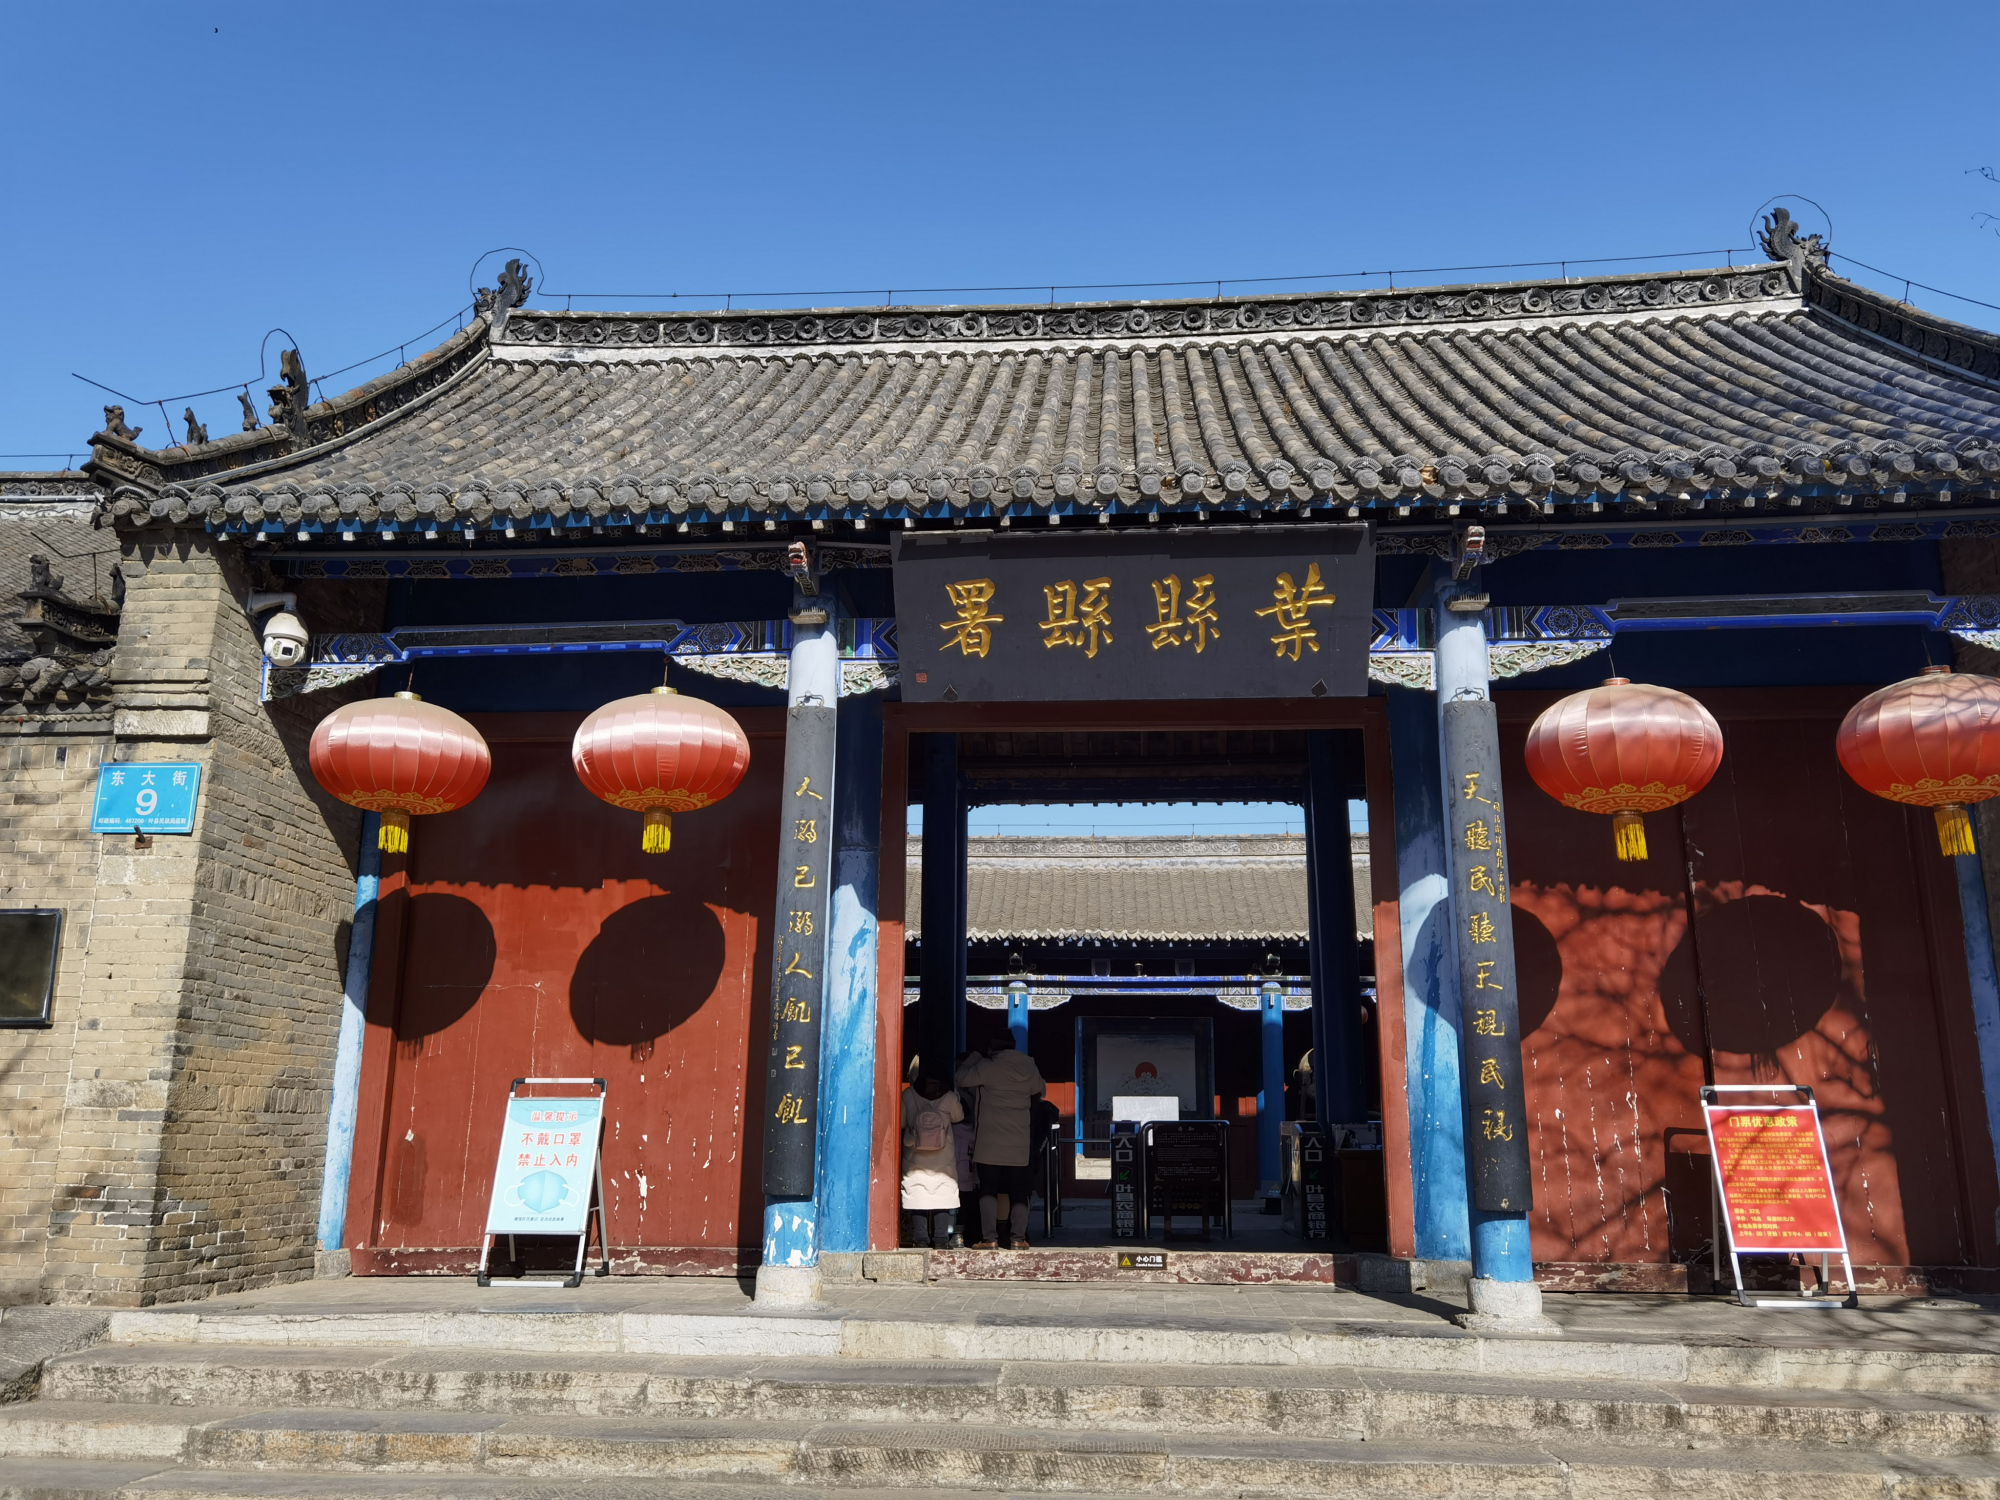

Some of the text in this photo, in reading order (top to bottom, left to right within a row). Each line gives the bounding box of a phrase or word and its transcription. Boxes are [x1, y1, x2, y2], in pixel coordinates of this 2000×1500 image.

[939, 562, 1336, 661] 葉縣縣署
[111, 770, 187, 786] 东大街
[135, 788, 158, 816] 9
[531, 1111, 578, 1122] 温馨提示
[1728, 1116, 1798, 1128] 门票优惠政策
[520, 1132, 582, 1146] 不戴口罩
[1115, 1136, 1133, 1162] 入口
[1304, 1136, 1323, 1162] 入口
[517, 1153, 578, 1167] 禁止入内
[1115, 1184, 1135, 1237] 叶县农商银行
[1305, 1185, 1327, 1239] 叶县农商银行
